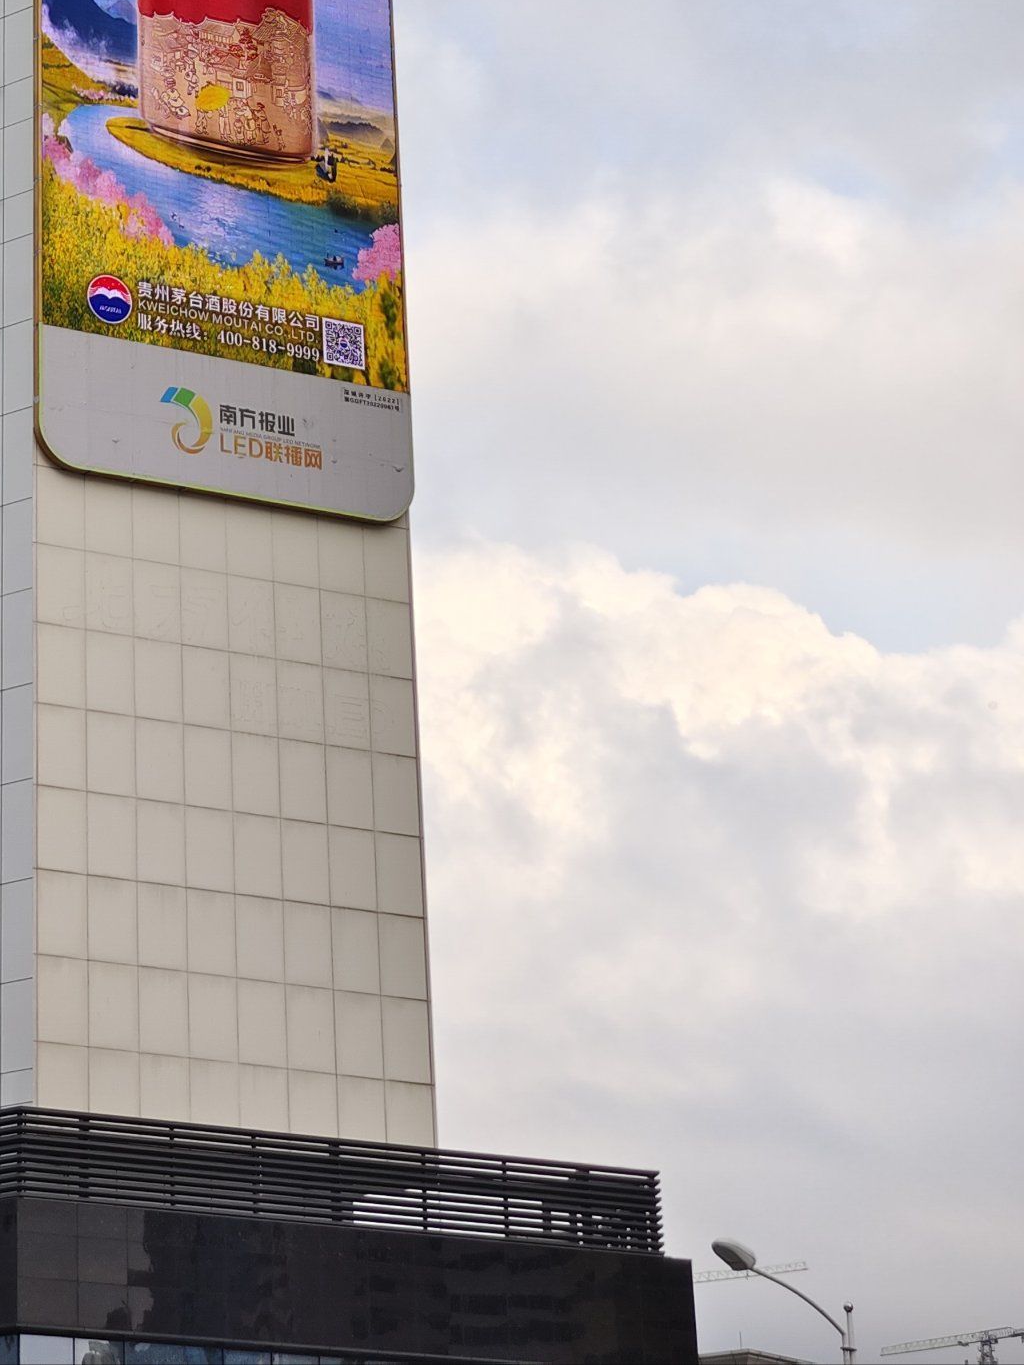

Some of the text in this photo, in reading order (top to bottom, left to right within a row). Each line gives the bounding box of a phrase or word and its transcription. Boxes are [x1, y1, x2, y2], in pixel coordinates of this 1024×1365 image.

[137, 280, 320, 332] 贵州茅台酒股份有限公司
[138, 299, 209, 322] KWEICHOW
[212, 313, 262, 333] MOUTAI
[217, 329, 320, 362] 400-818-9999
[219, 404, 296, 437] 南方报业
[219, 433, 323, 471] LED联播网
